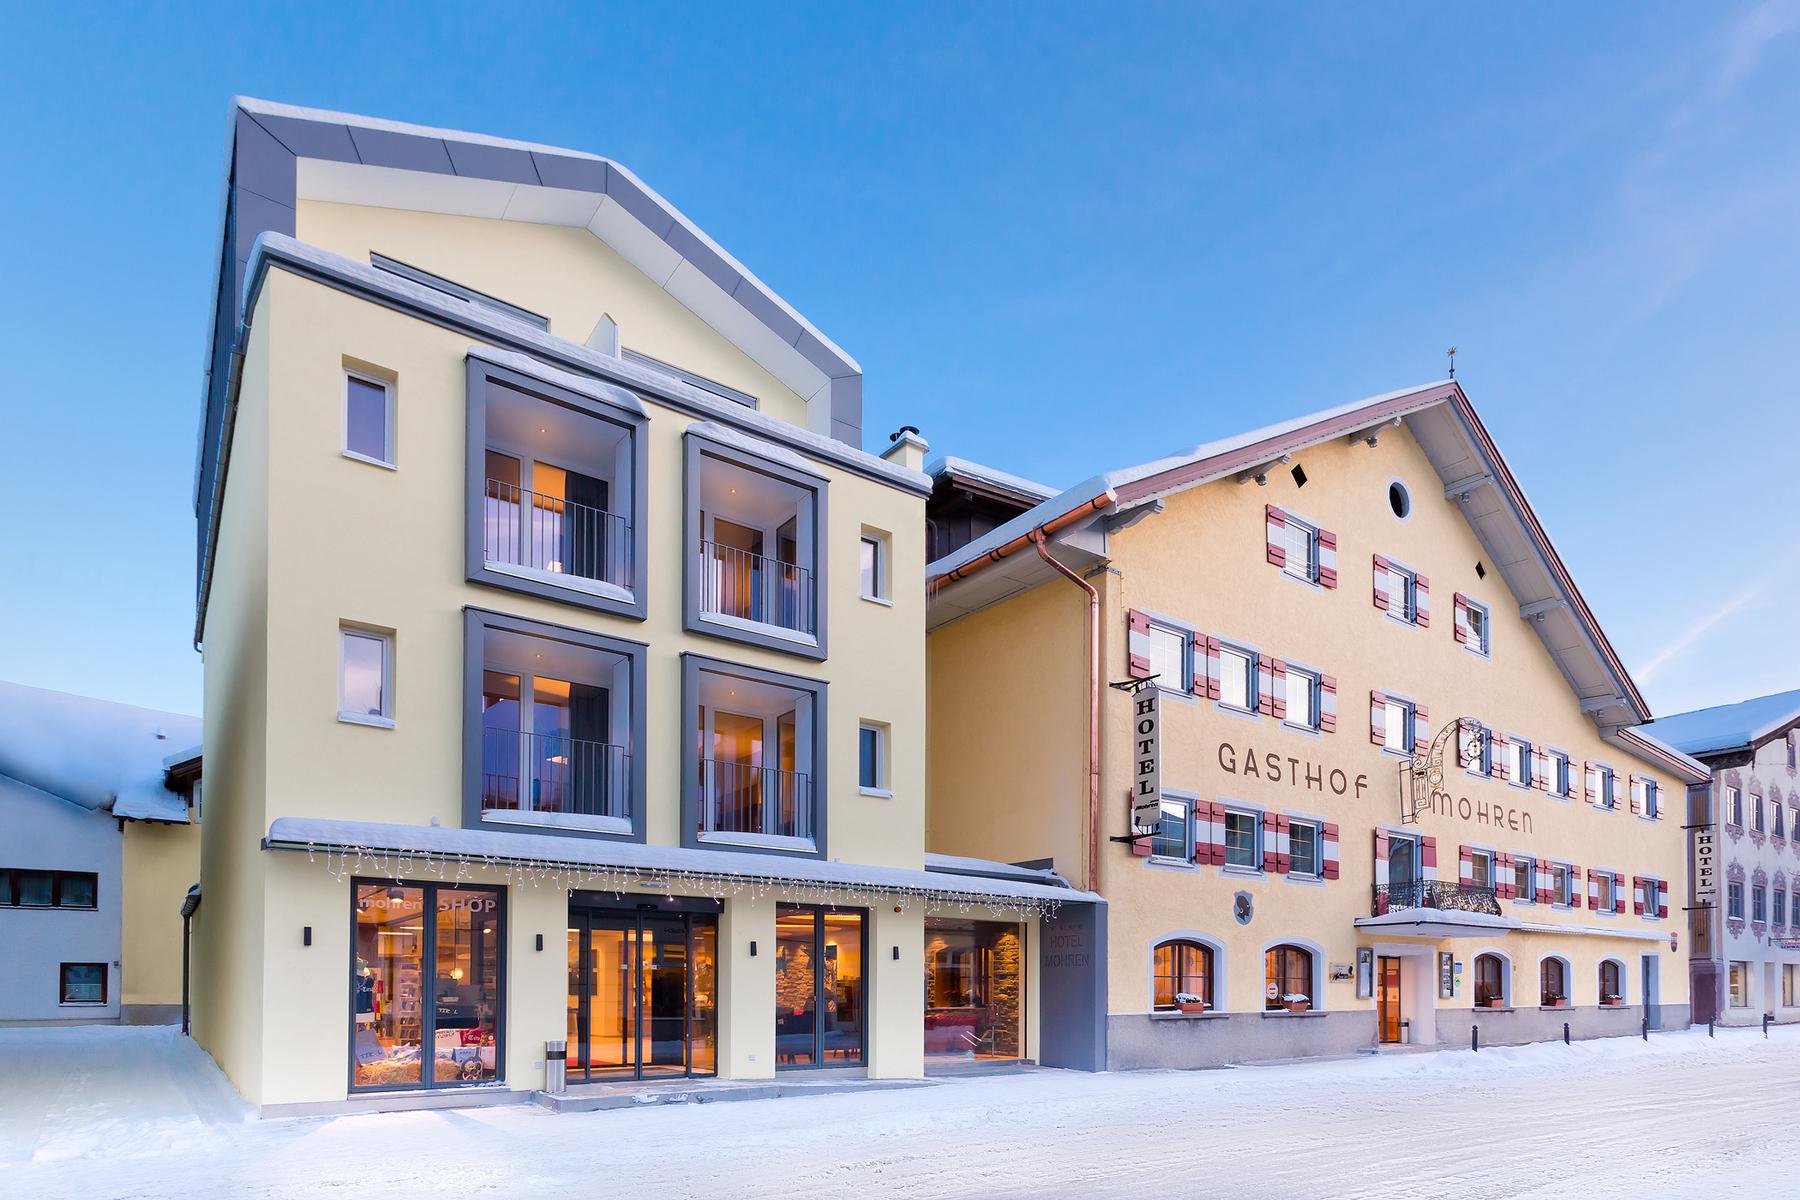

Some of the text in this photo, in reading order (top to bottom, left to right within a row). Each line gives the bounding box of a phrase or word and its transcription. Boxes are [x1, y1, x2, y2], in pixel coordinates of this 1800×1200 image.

[1136, 697, 1155, 796] HOTEL
[1218, 742, 1533, 834] GASTHOF MOHREN
[1697, 835, 1713, 887] HOTEL
[358, 896, 497, 913] mohren SHOP
[1050, 934, 1084, 948] HOTEL
[1045, 951, 1089, 968] MOHREN
